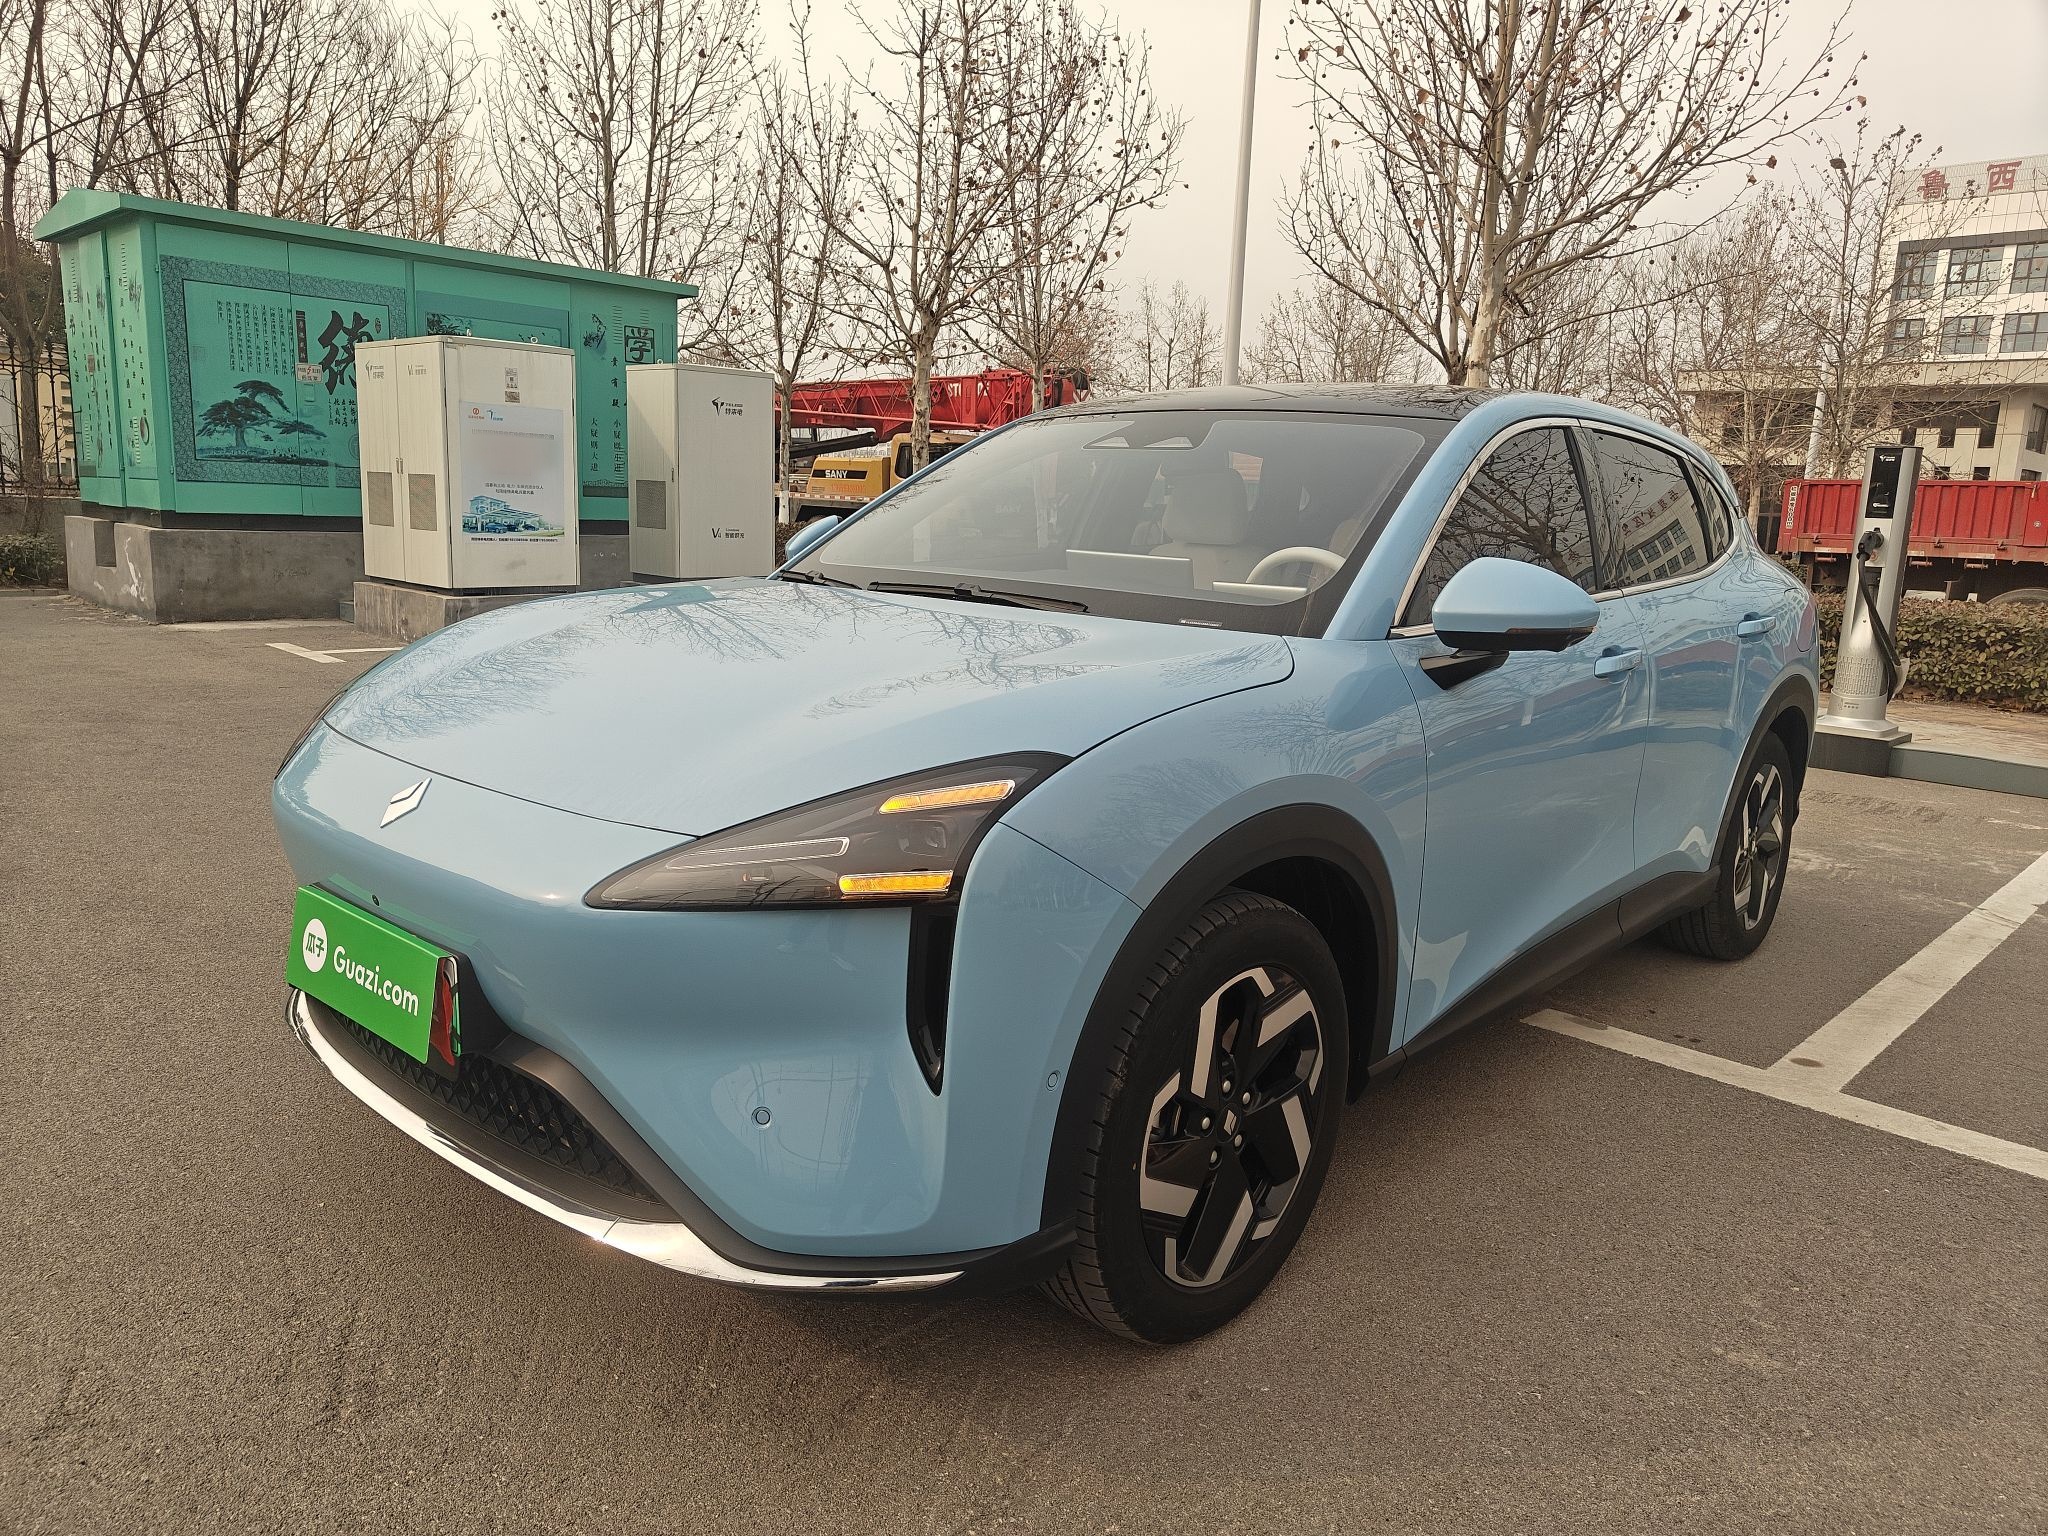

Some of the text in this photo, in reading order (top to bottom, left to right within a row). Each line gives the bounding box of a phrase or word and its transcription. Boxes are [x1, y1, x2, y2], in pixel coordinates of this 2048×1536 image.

[1916, 160, 2023, 200] 鲁西
[626, 326, 653, 363] 学
[825, 469, 848, 479] SANY
[306, 932, 325, 957] 瓜子
[333, 945, 419, 1016] Guazi.com
